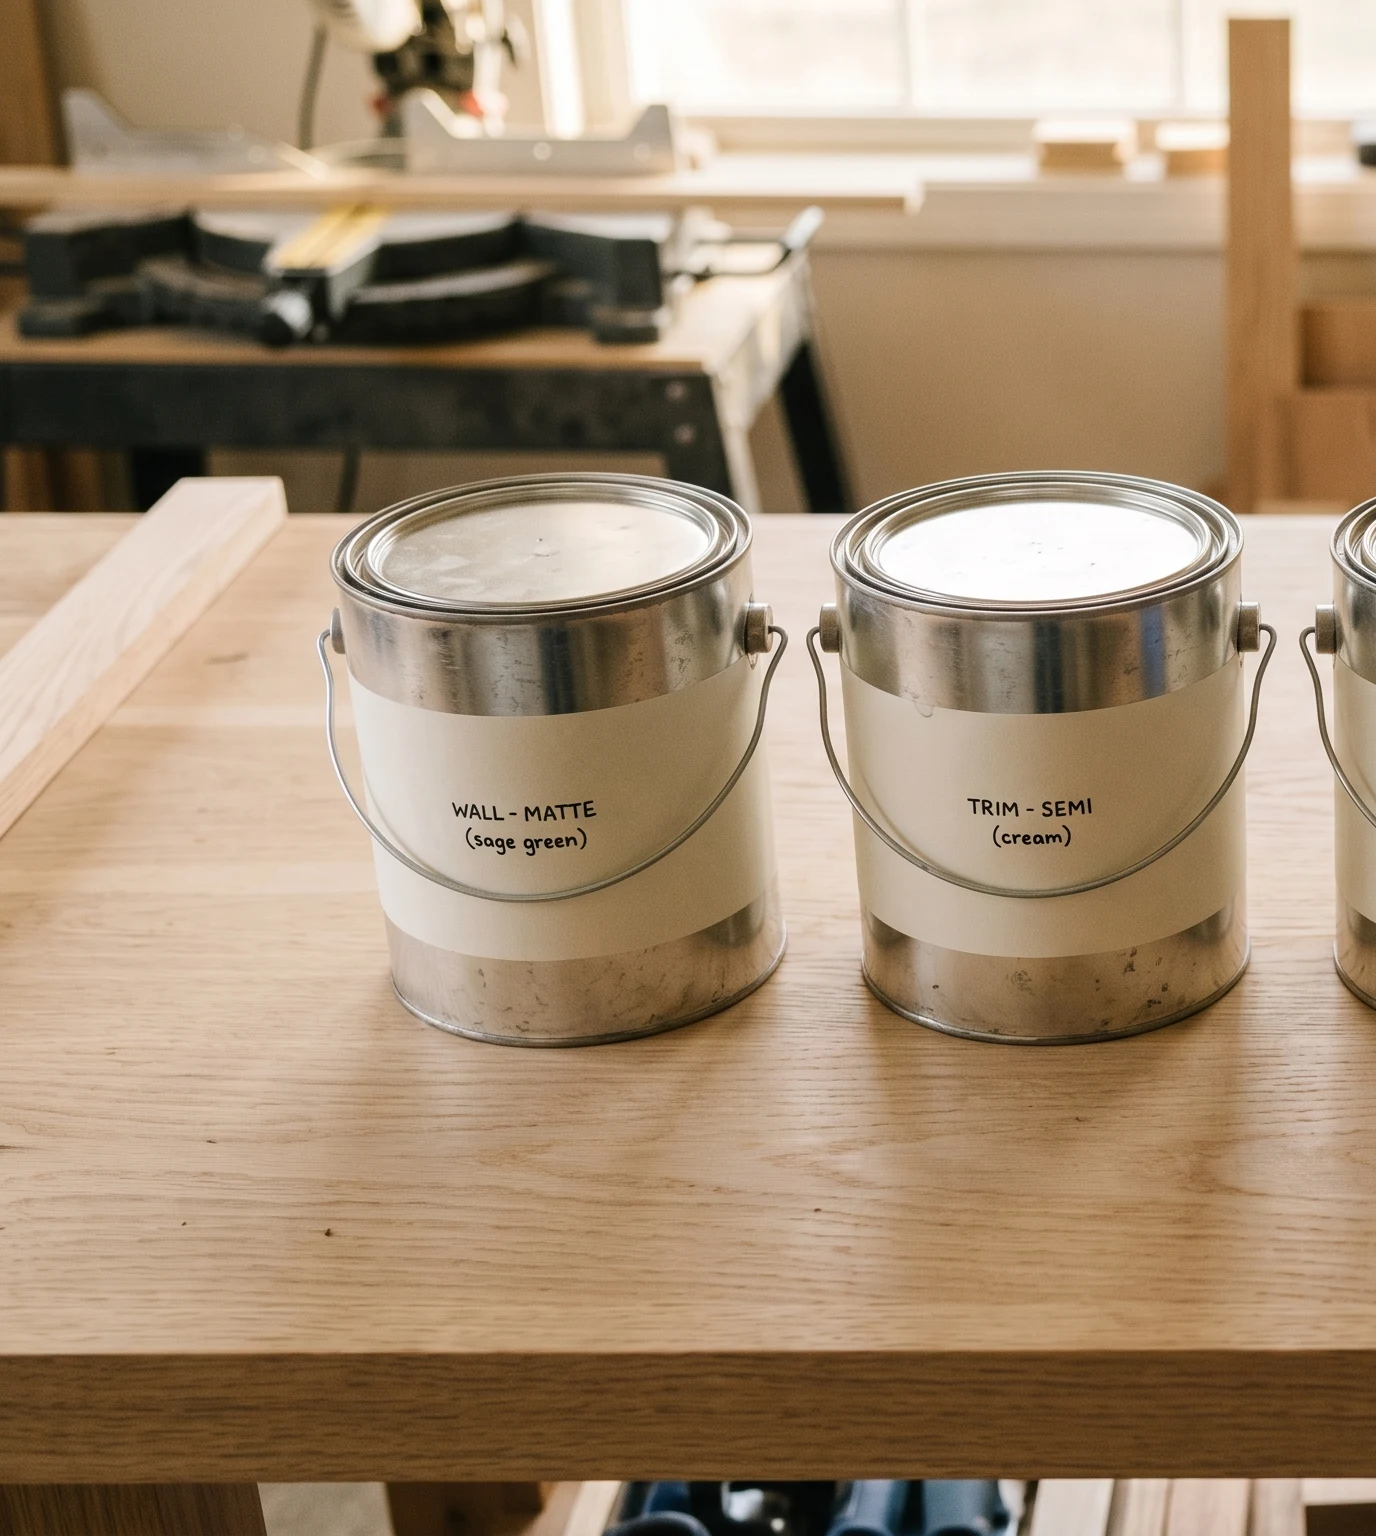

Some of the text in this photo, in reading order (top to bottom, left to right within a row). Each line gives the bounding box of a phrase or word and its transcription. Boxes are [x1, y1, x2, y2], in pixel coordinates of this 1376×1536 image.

[451, 801, 505, 821] WALL
[524, 800, 597, 822] MATTE
[966, 797, 1020, 818] TRIM
[1041, 797, 1093, 818] SEMI
[465, 826, 588, 857] (sage green)
[992, 824, 1072, 848] (cream)
